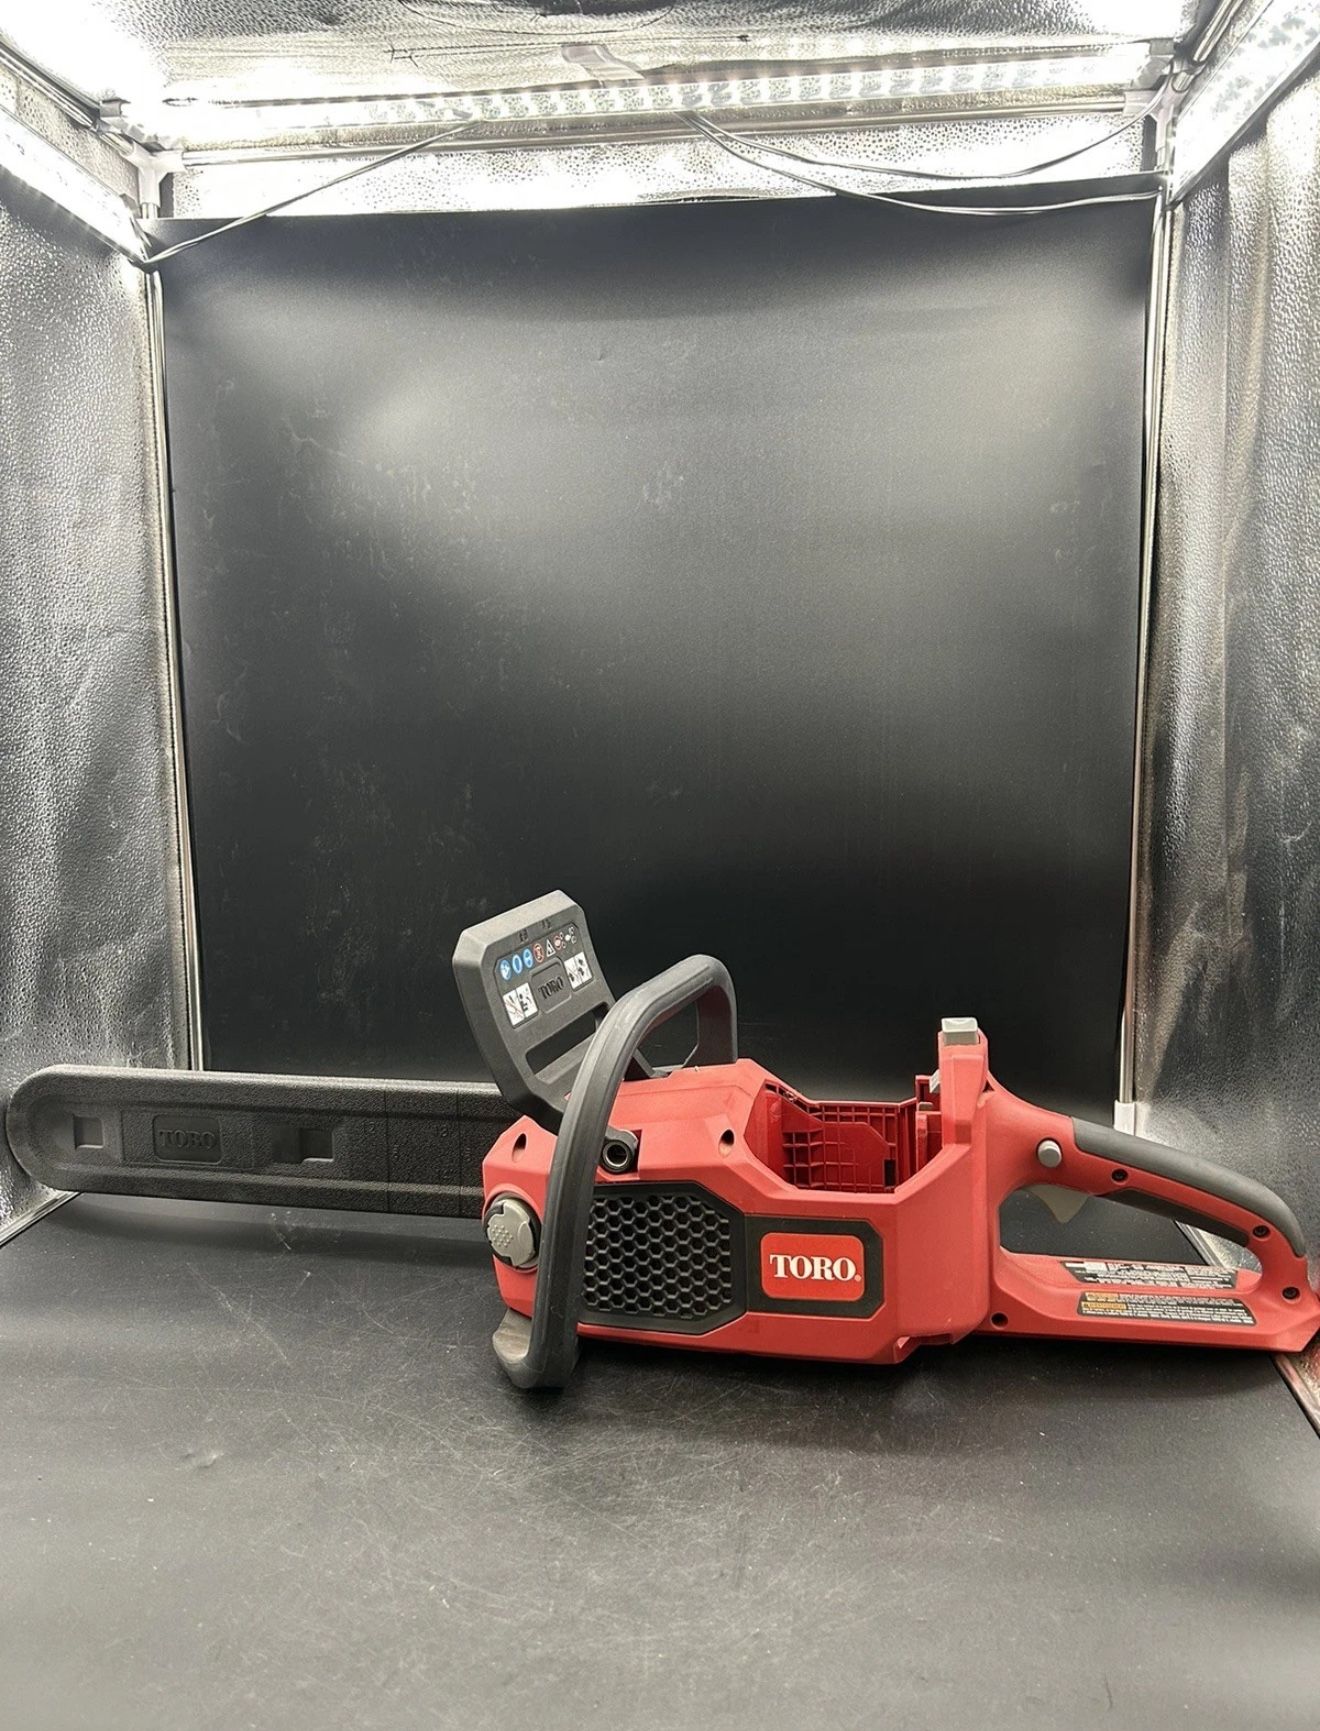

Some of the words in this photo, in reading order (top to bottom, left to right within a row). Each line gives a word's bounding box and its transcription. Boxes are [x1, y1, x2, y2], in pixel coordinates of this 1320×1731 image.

[538, 976, 564, 999] TORO
[159, 1129, 217, 1149] TORO
[769, 1254, 858, 1281] TORO
